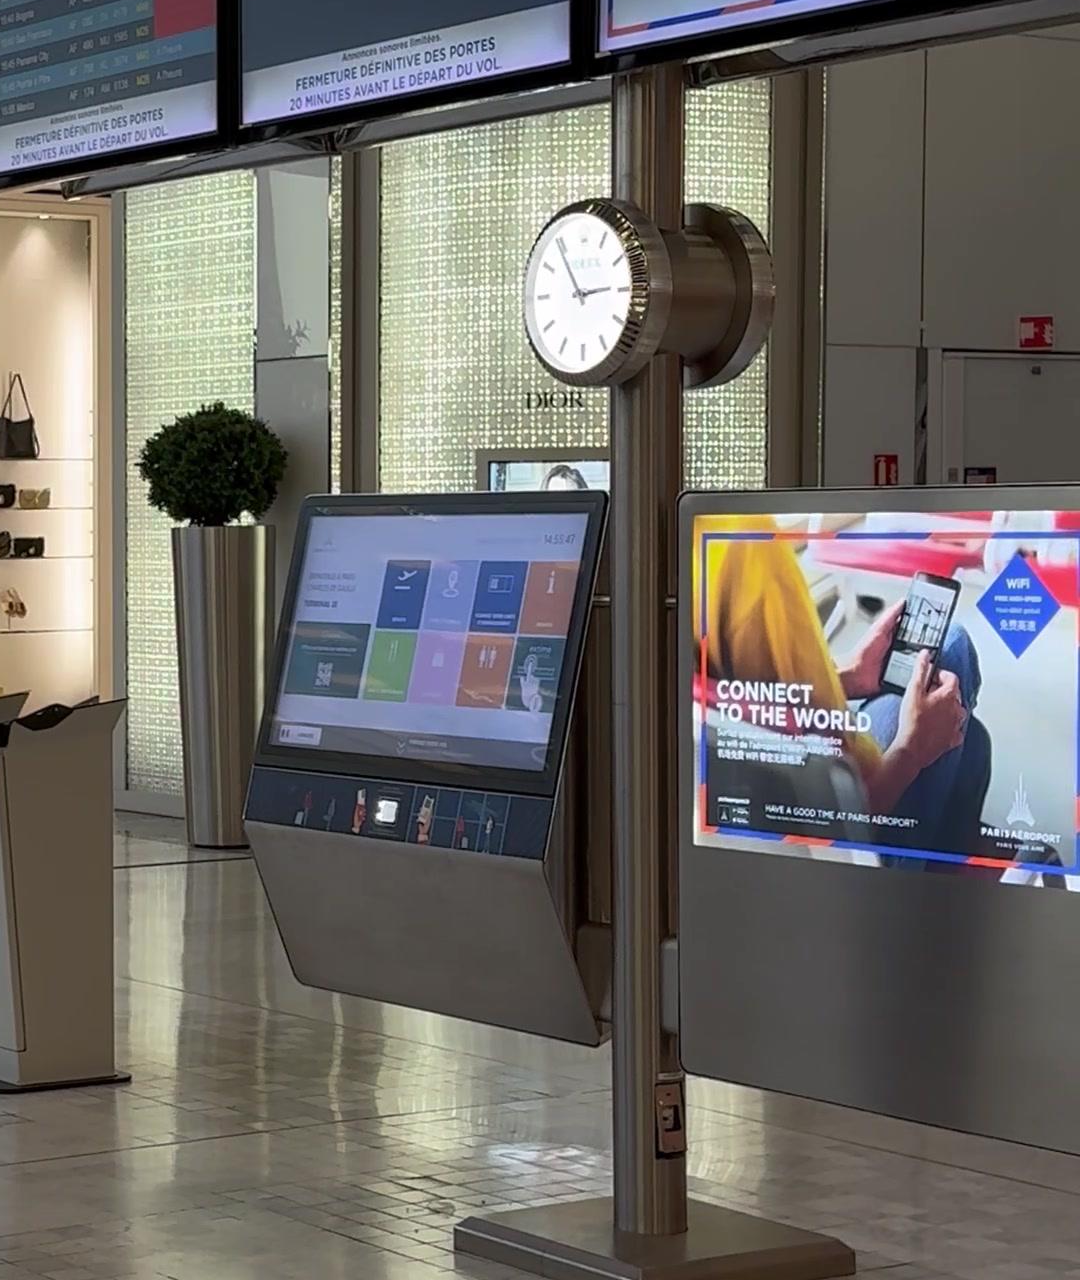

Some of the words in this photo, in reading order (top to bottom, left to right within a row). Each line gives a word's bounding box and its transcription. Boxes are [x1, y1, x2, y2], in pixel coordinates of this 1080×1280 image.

[379, 40, 409, 56] sonores
[295, 65, 358, 92] FERMETURE
[360, 53, 421, 77] DÉFINITIVE
[424, 47, 446, 65] DES
[450, 36, 496, 59] PORTES
[289, 96, 303, 112] 20
[305, 86, 352, 109] MINUTES
[354, 78, 390, 99] AVANT
[393, 74, 406, 90] LE
[409, 64, 453, 88] DÉPART
[456, 60, 473, 78] DU
[15, 129, 62, 149] FERMETURE
[63, 121, 110, 140] DÉFINITIVE
[111, 116, 128, 130] DES
[129, 107, 164, 126] PORTES
[11, 153, 21, 167] 20
[22, 146, 58, 164] MINUTES
[59, 141, 86, 158] AVANT
[88, 139, 99, 152] LE
[100, 131, 133, 149] DÉPART
[134, 128, 148, 141] DU
[526, 391, 584, 410] DIOR
[716, 679, 813, 705] CONNECT
[716, 702, 743, 723] TO
[748, 704, 787, 726] THE
[792, 706, 872, 733] WORLD
[764, 804, 785, 815] HAVE
[785, 806, 792, 815] A
[793, 807, 816, 818] GOOD
[817, 809, 835, 820] TIME
[836, 811, 847, 821] AT
[847, 812, 870, 823] PARIS
[980, 826, 1009, 839] PARIS
[1010, 829, 1062, 844] AÉROPORT
